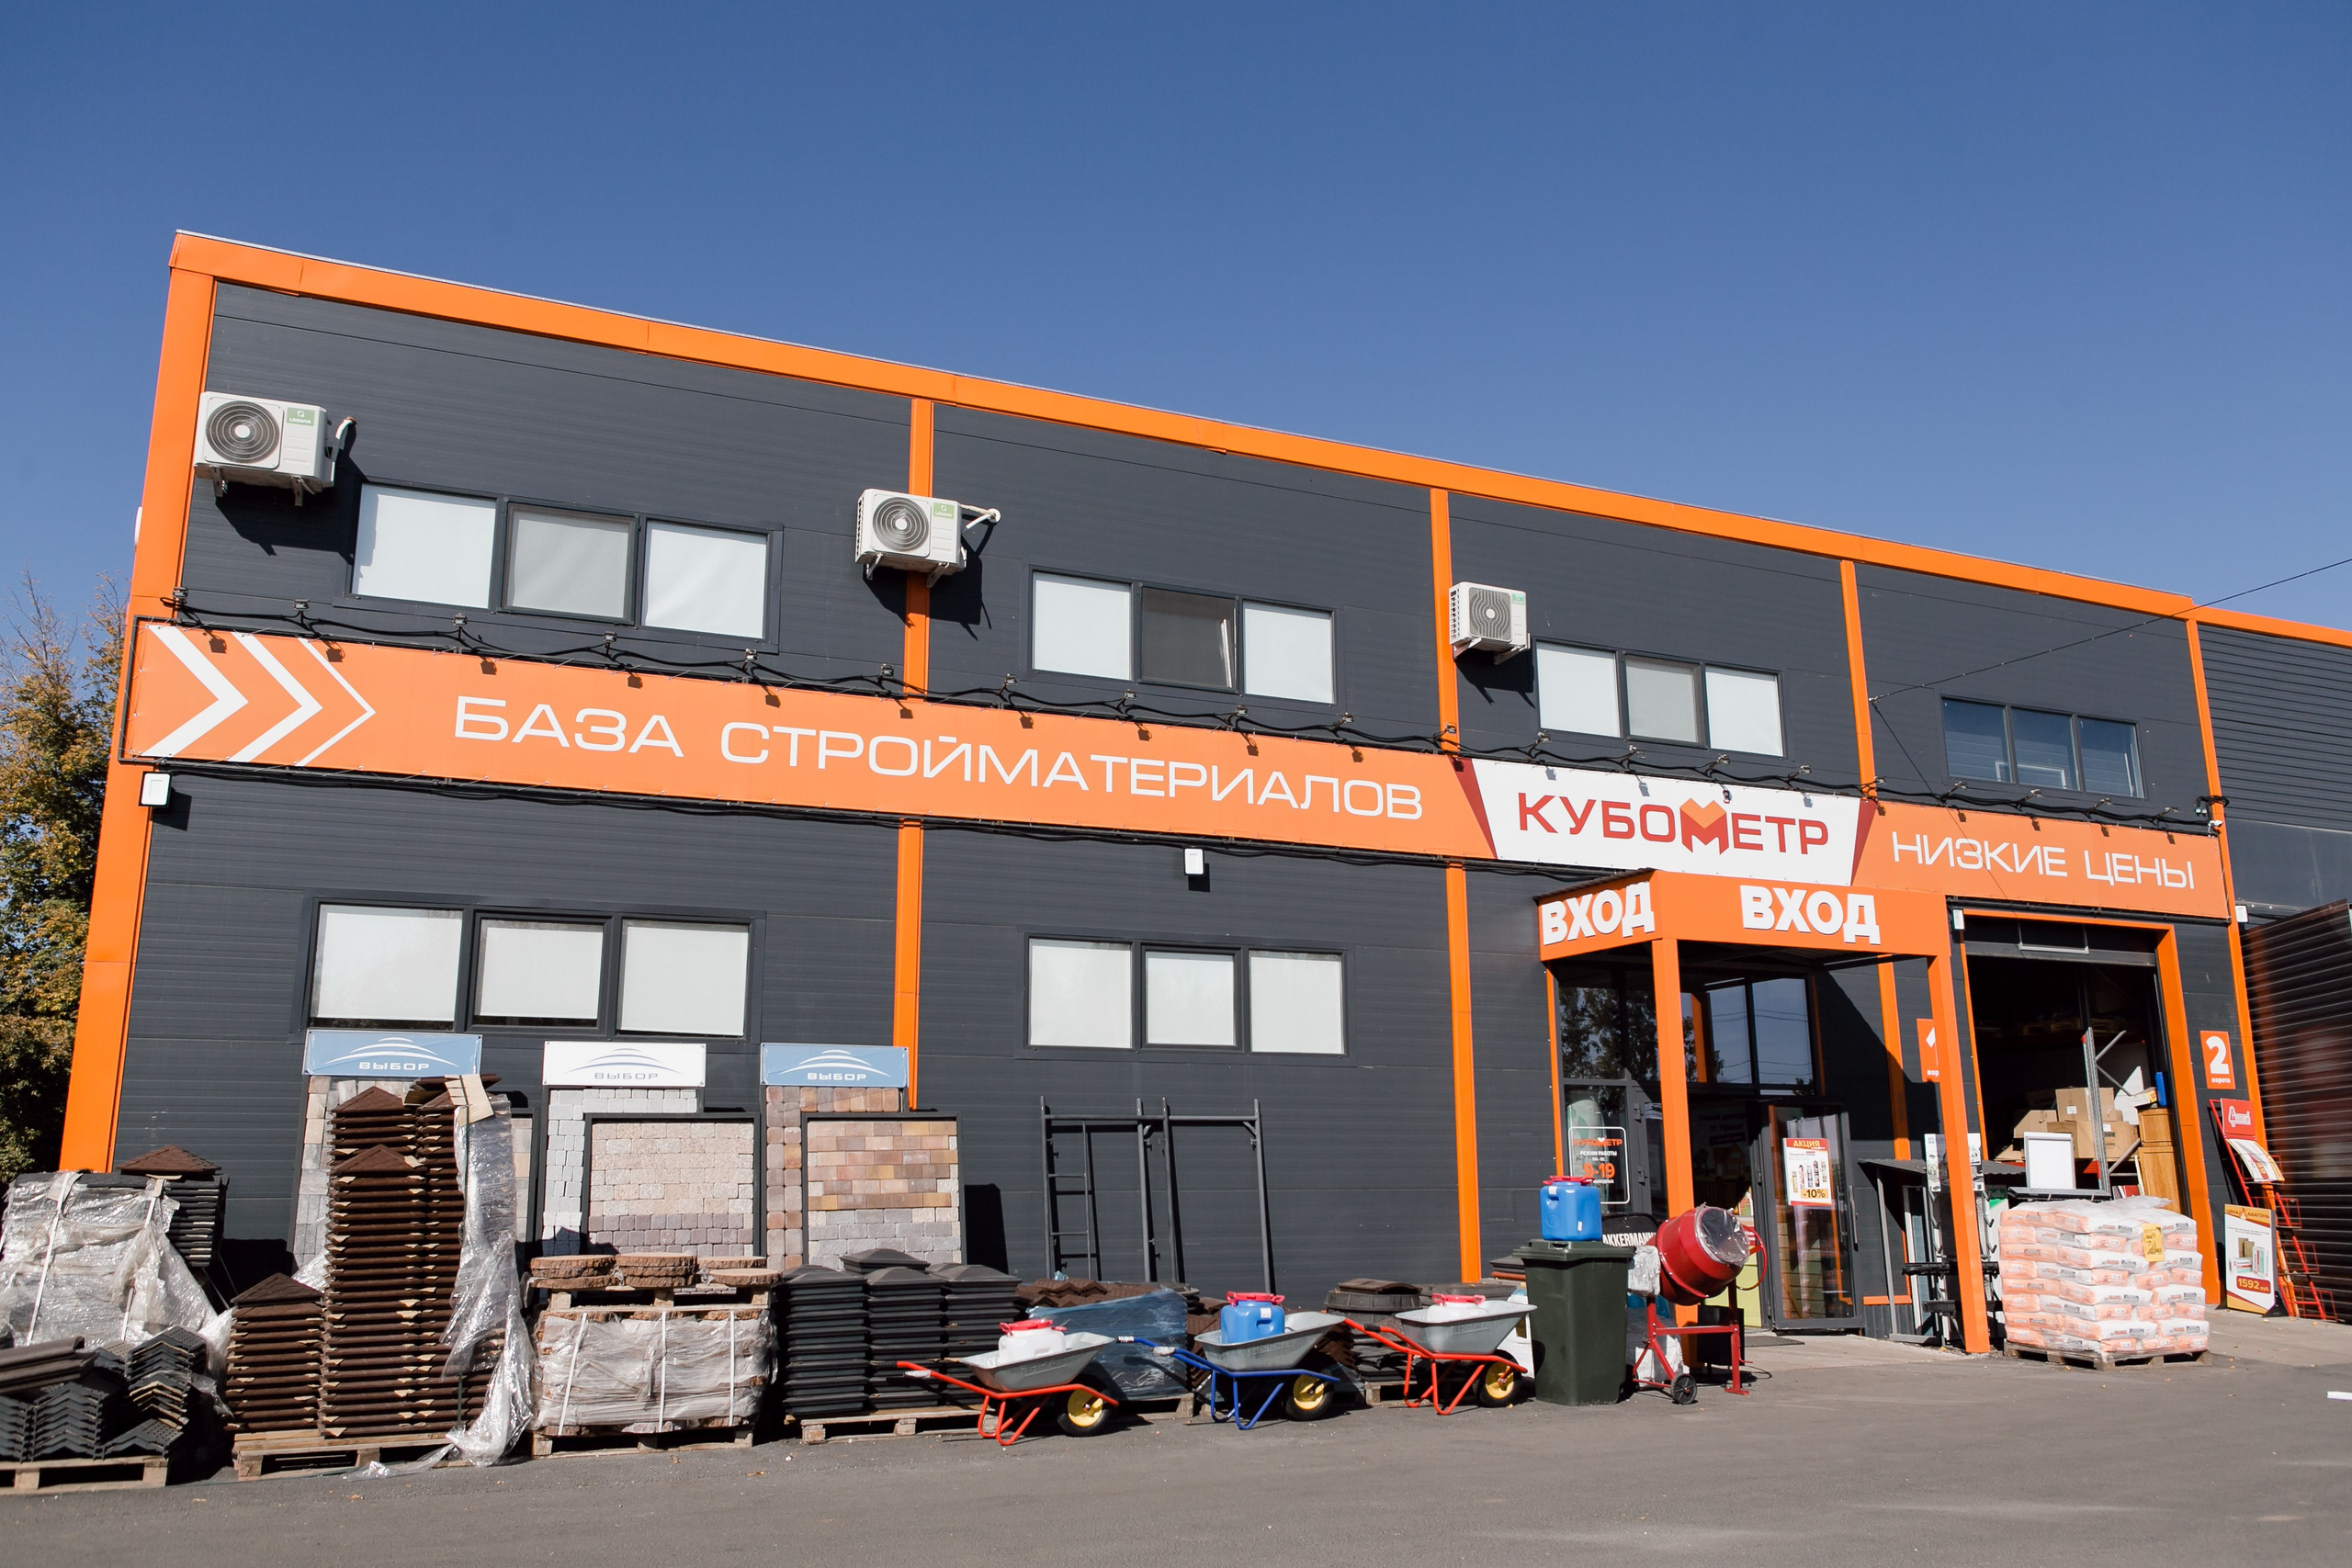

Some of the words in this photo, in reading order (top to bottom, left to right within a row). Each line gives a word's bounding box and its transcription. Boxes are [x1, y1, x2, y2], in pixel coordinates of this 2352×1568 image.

[455, 696, 684, 757] БАЗА
[721, 722, 1422, 819] СТРОЙМАТЕРИАЛОВ
[1519, 797, 1828, 855] КУБОМЕТР
[1892, 831, 2068, 877] НИЗКИЕ
[2084, 850, 2195, 890] ЦЕНЫ
[1542, 882, 1656, 945] ВХОД
[1740, 885, 1881, 945] ВХОД
[2206, 1036, 2230, 1074] 2
[358, 1061, 430, 1071] ВЫБОР
[594, 1072, 659, 1080] ВЫБОР
[807, 1072, 866, 1081] ВЫБОР
[1573, 1137, 1623, 1147] КУБОМЕТР
[1792, 1140, 1820, 1148] АКЦИЯ
[1582, 1163, 1615, 1179] 9-19
[1803, 1189, 1826, 1198] -10%
[2237, 1278, 2259, 1290] 1592
